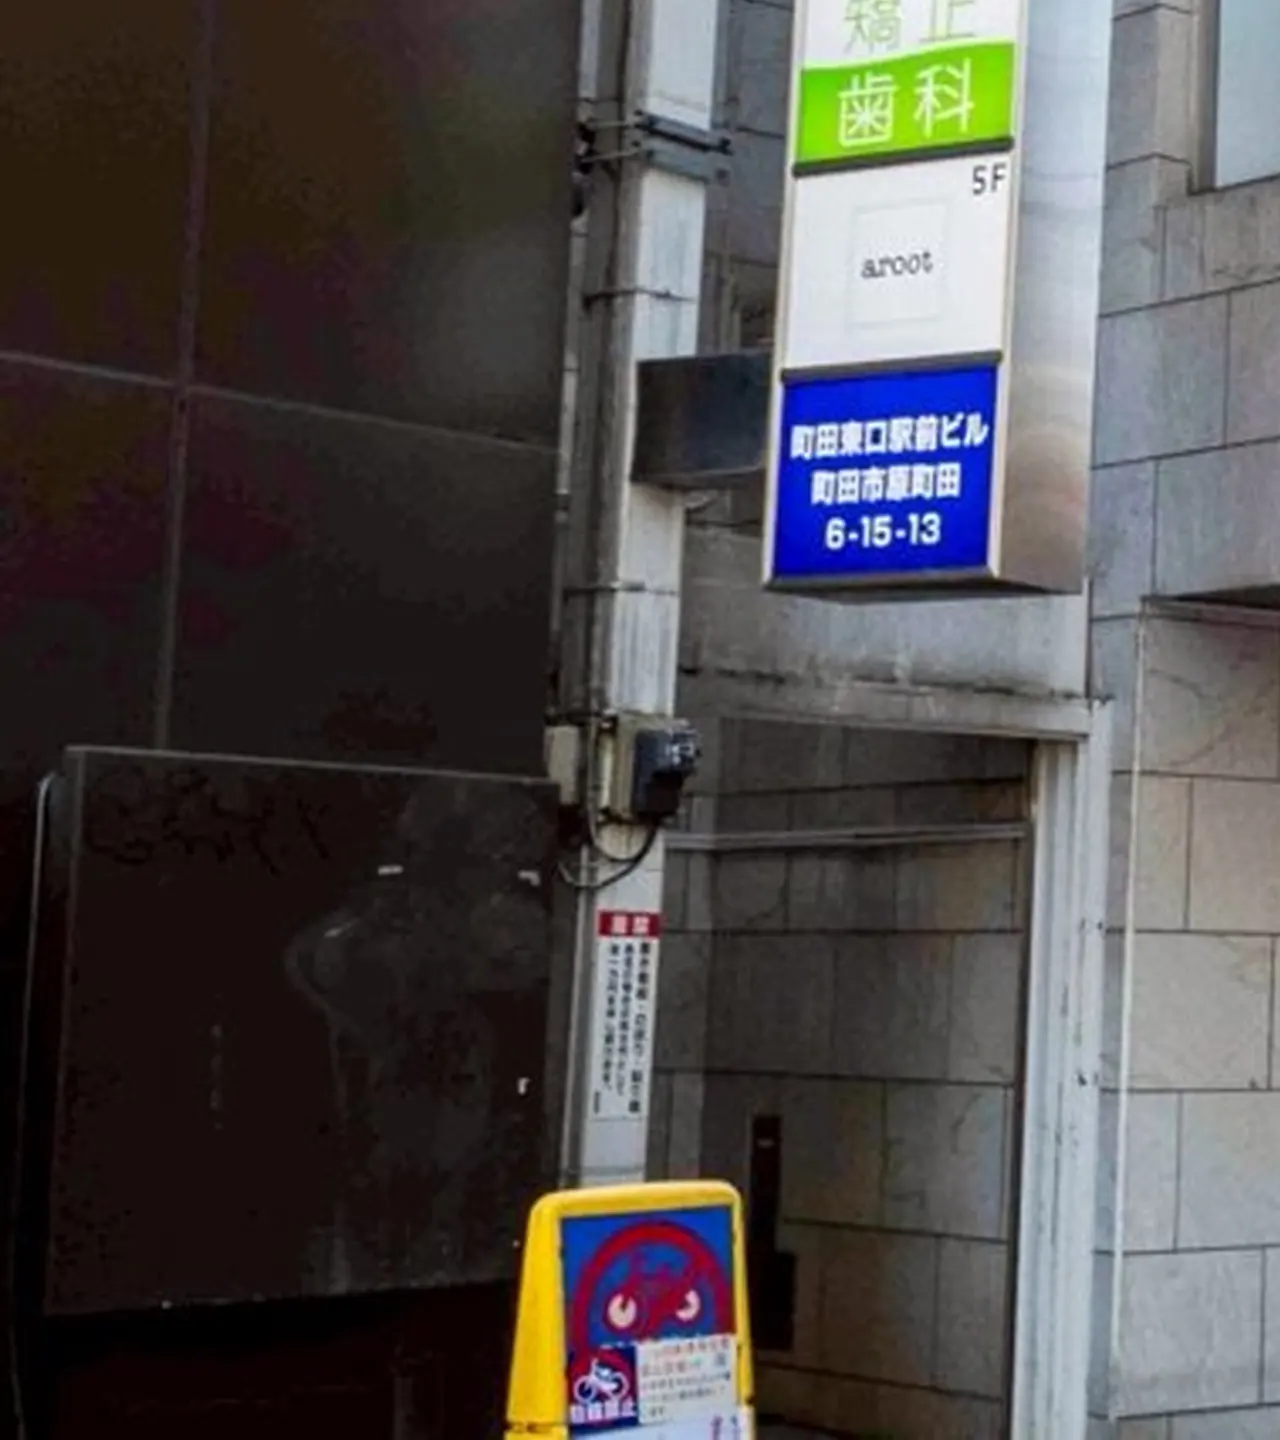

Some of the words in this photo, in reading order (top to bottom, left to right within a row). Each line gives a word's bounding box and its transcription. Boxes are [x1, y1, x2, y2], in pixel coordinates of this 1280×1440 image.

[837, 56, 975, 147] 歯科
[972, 162, 1006, 196] 5F
[790, 411, 990, 460] 町田東口駅前ビル
[811, 462, 961, 506] 町田市原町田
[825, 511, 942, 550] 6-15-13
